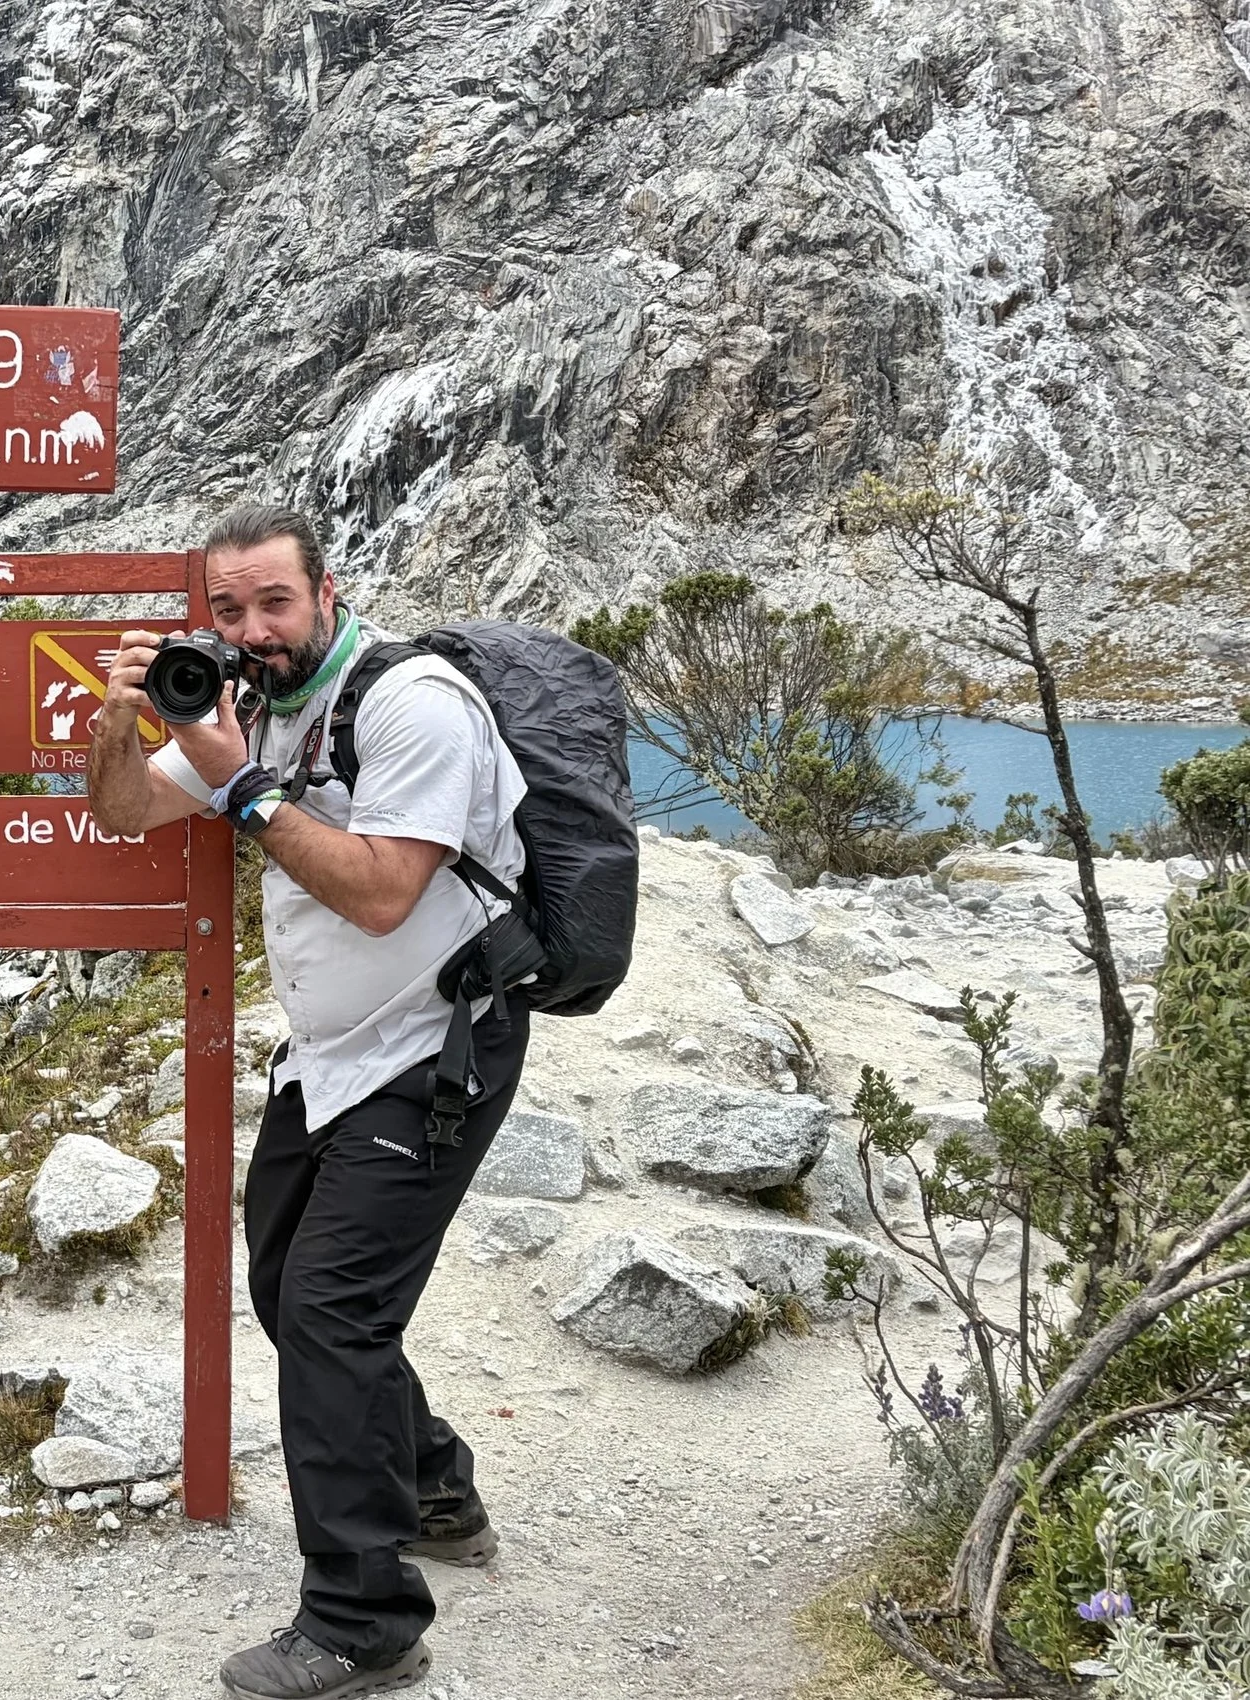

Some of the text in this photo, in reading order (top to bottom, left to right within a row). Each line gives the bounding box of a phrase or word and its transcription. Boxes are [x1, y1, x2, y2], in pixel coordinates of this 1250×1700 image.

[31, 750, 56, 768] No
[4, 810, 54, 844] de
[372, 1136, 419, 1161] MERRELL
